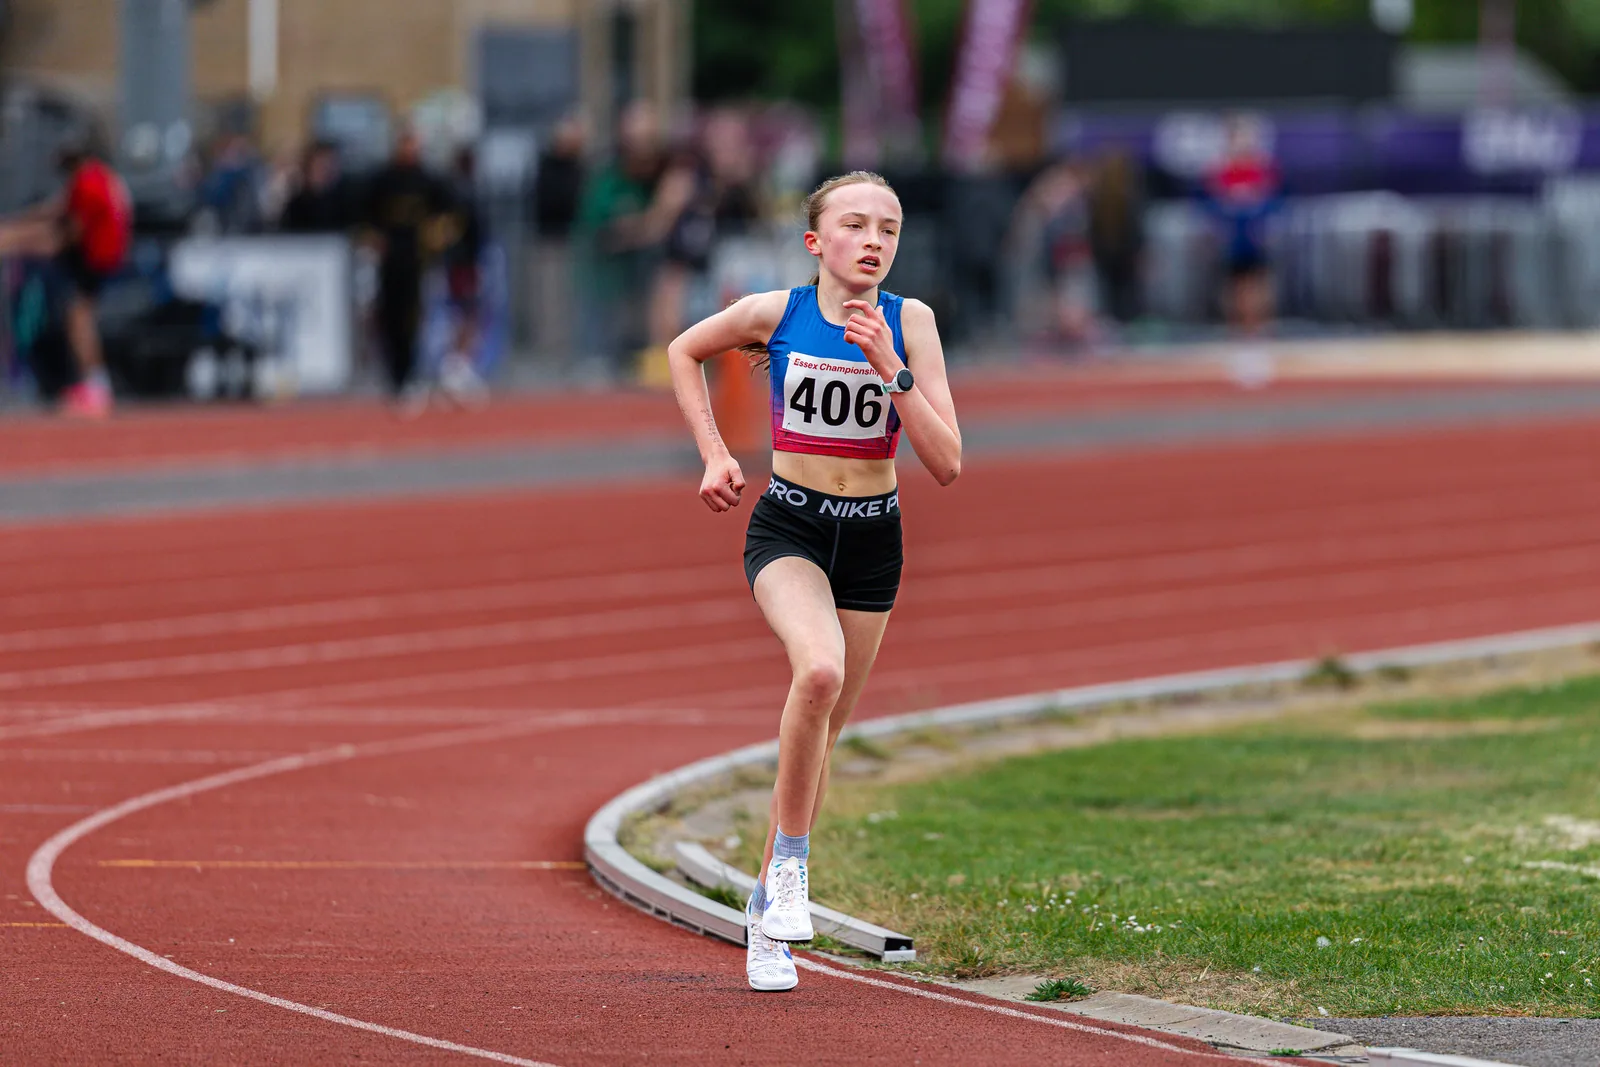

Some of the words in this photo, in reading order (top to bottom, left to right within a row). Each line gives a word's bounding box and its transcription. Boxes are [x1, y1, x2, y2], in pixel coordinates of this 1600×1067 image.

[793, 358, 818, 370] Essex
[790, 376, 884, 428] 406
[818, 498, 883, 518] NIKE
[886, 492, 899, 513] P
